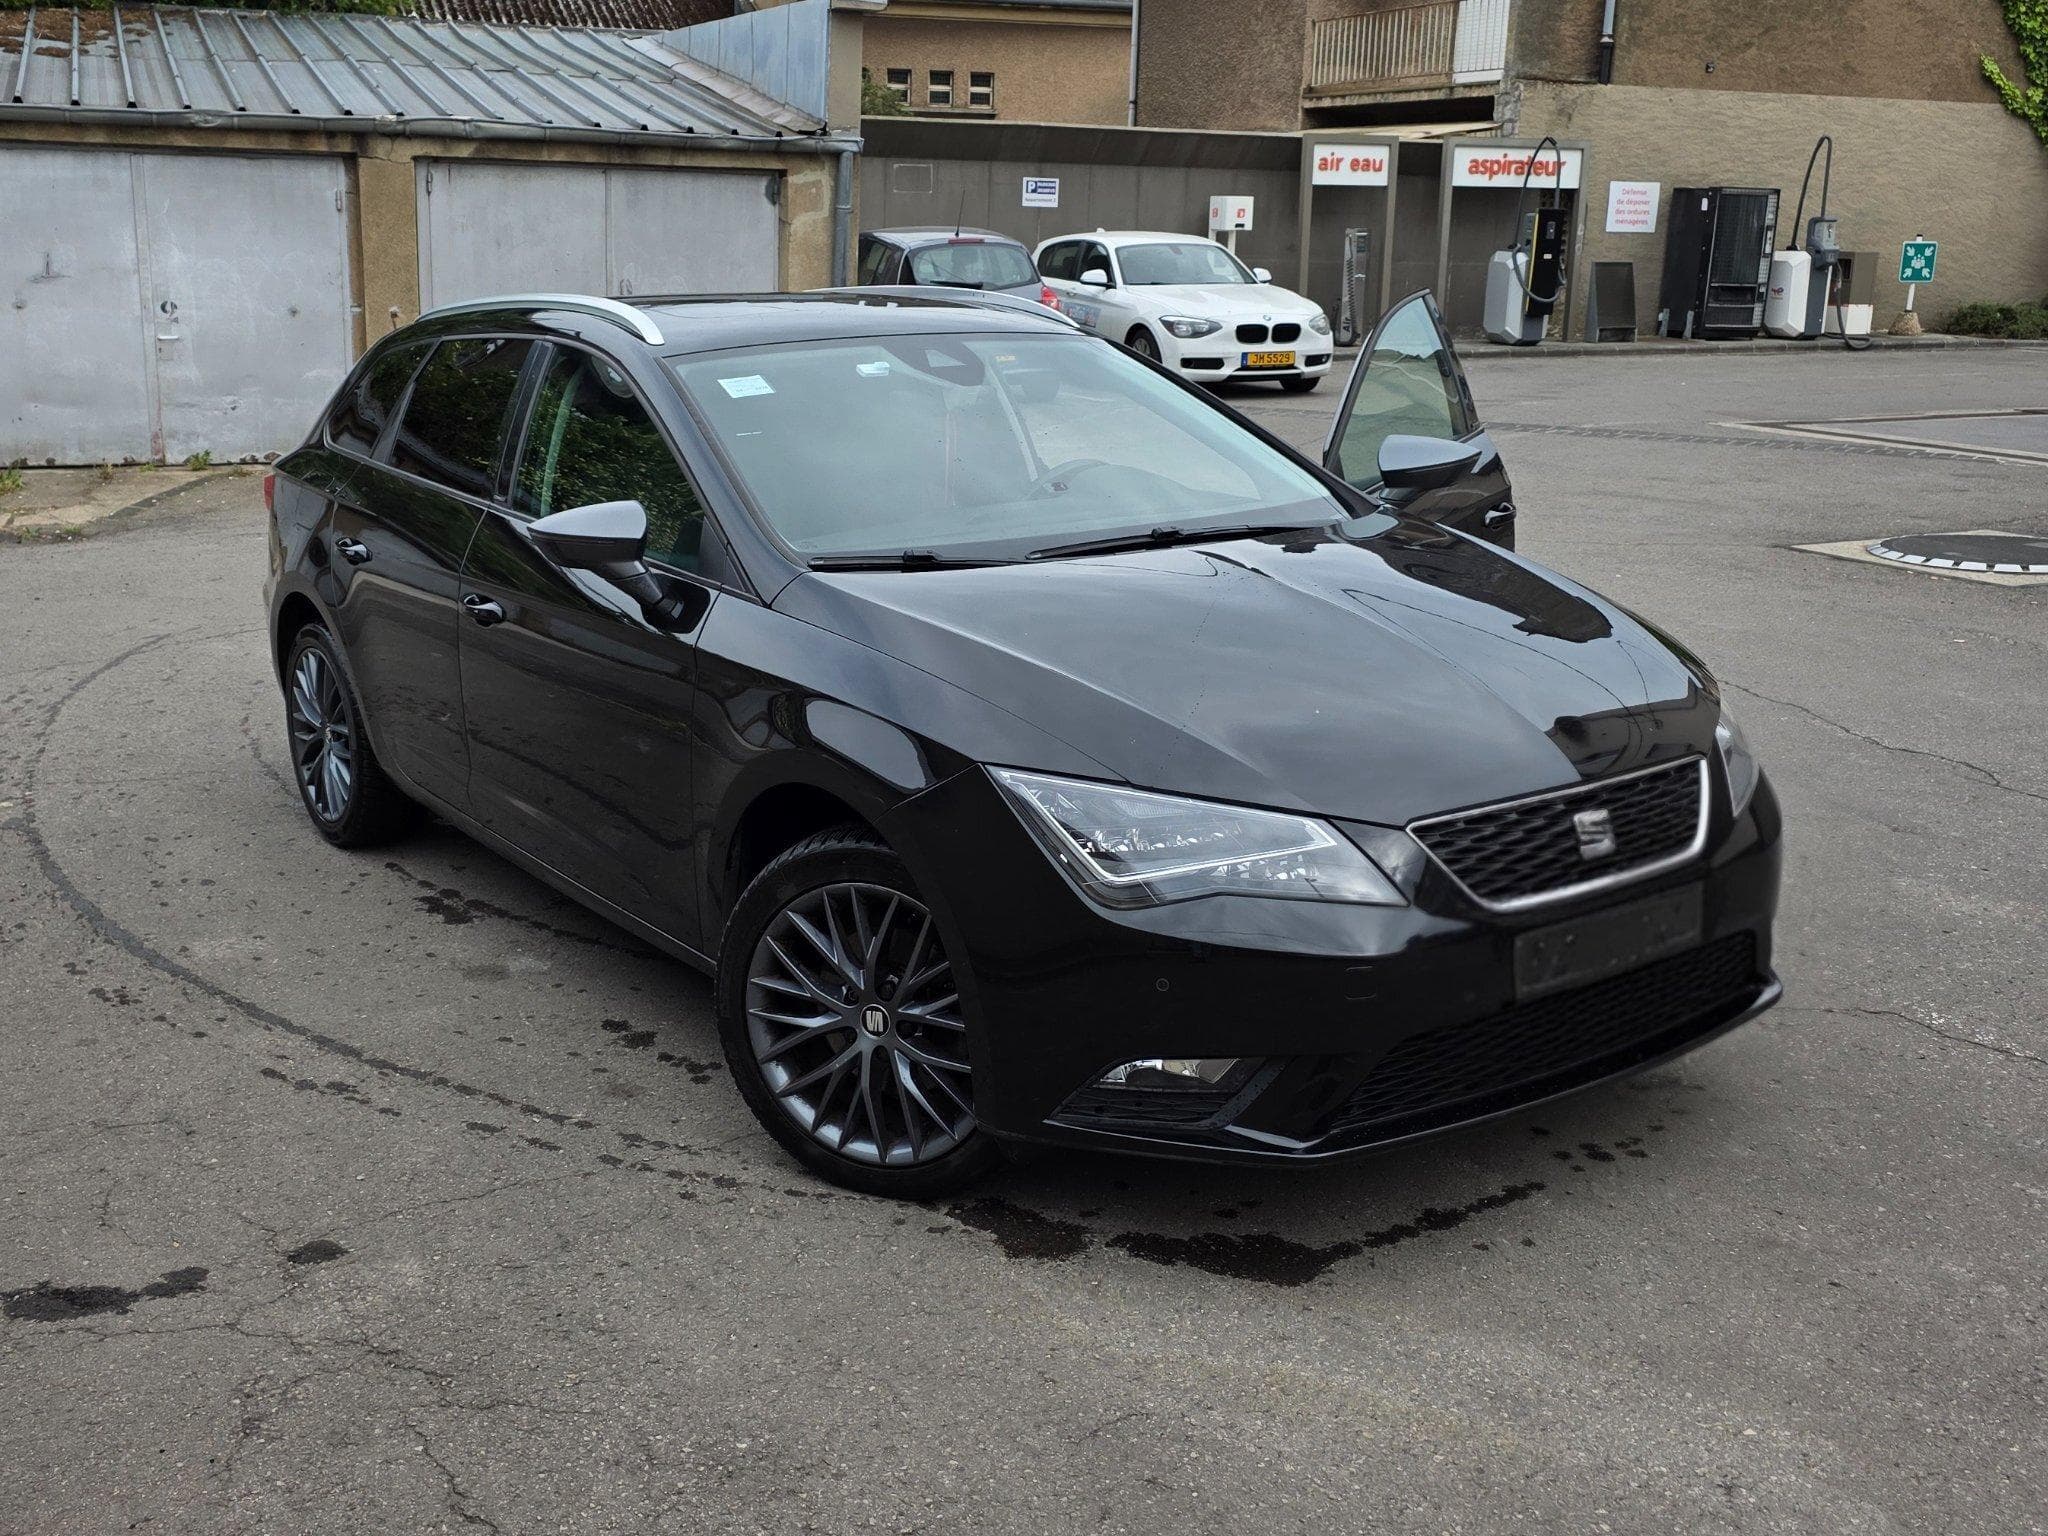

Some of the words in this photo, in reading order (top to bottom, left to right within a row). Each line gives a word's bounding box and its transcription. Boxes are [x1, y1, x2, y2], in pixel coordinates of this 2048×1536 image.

[1318, 151, 1344, 171] air
[1350, 157, 1383, 172] eau
[1266, 353, 1290, 363] 5529
